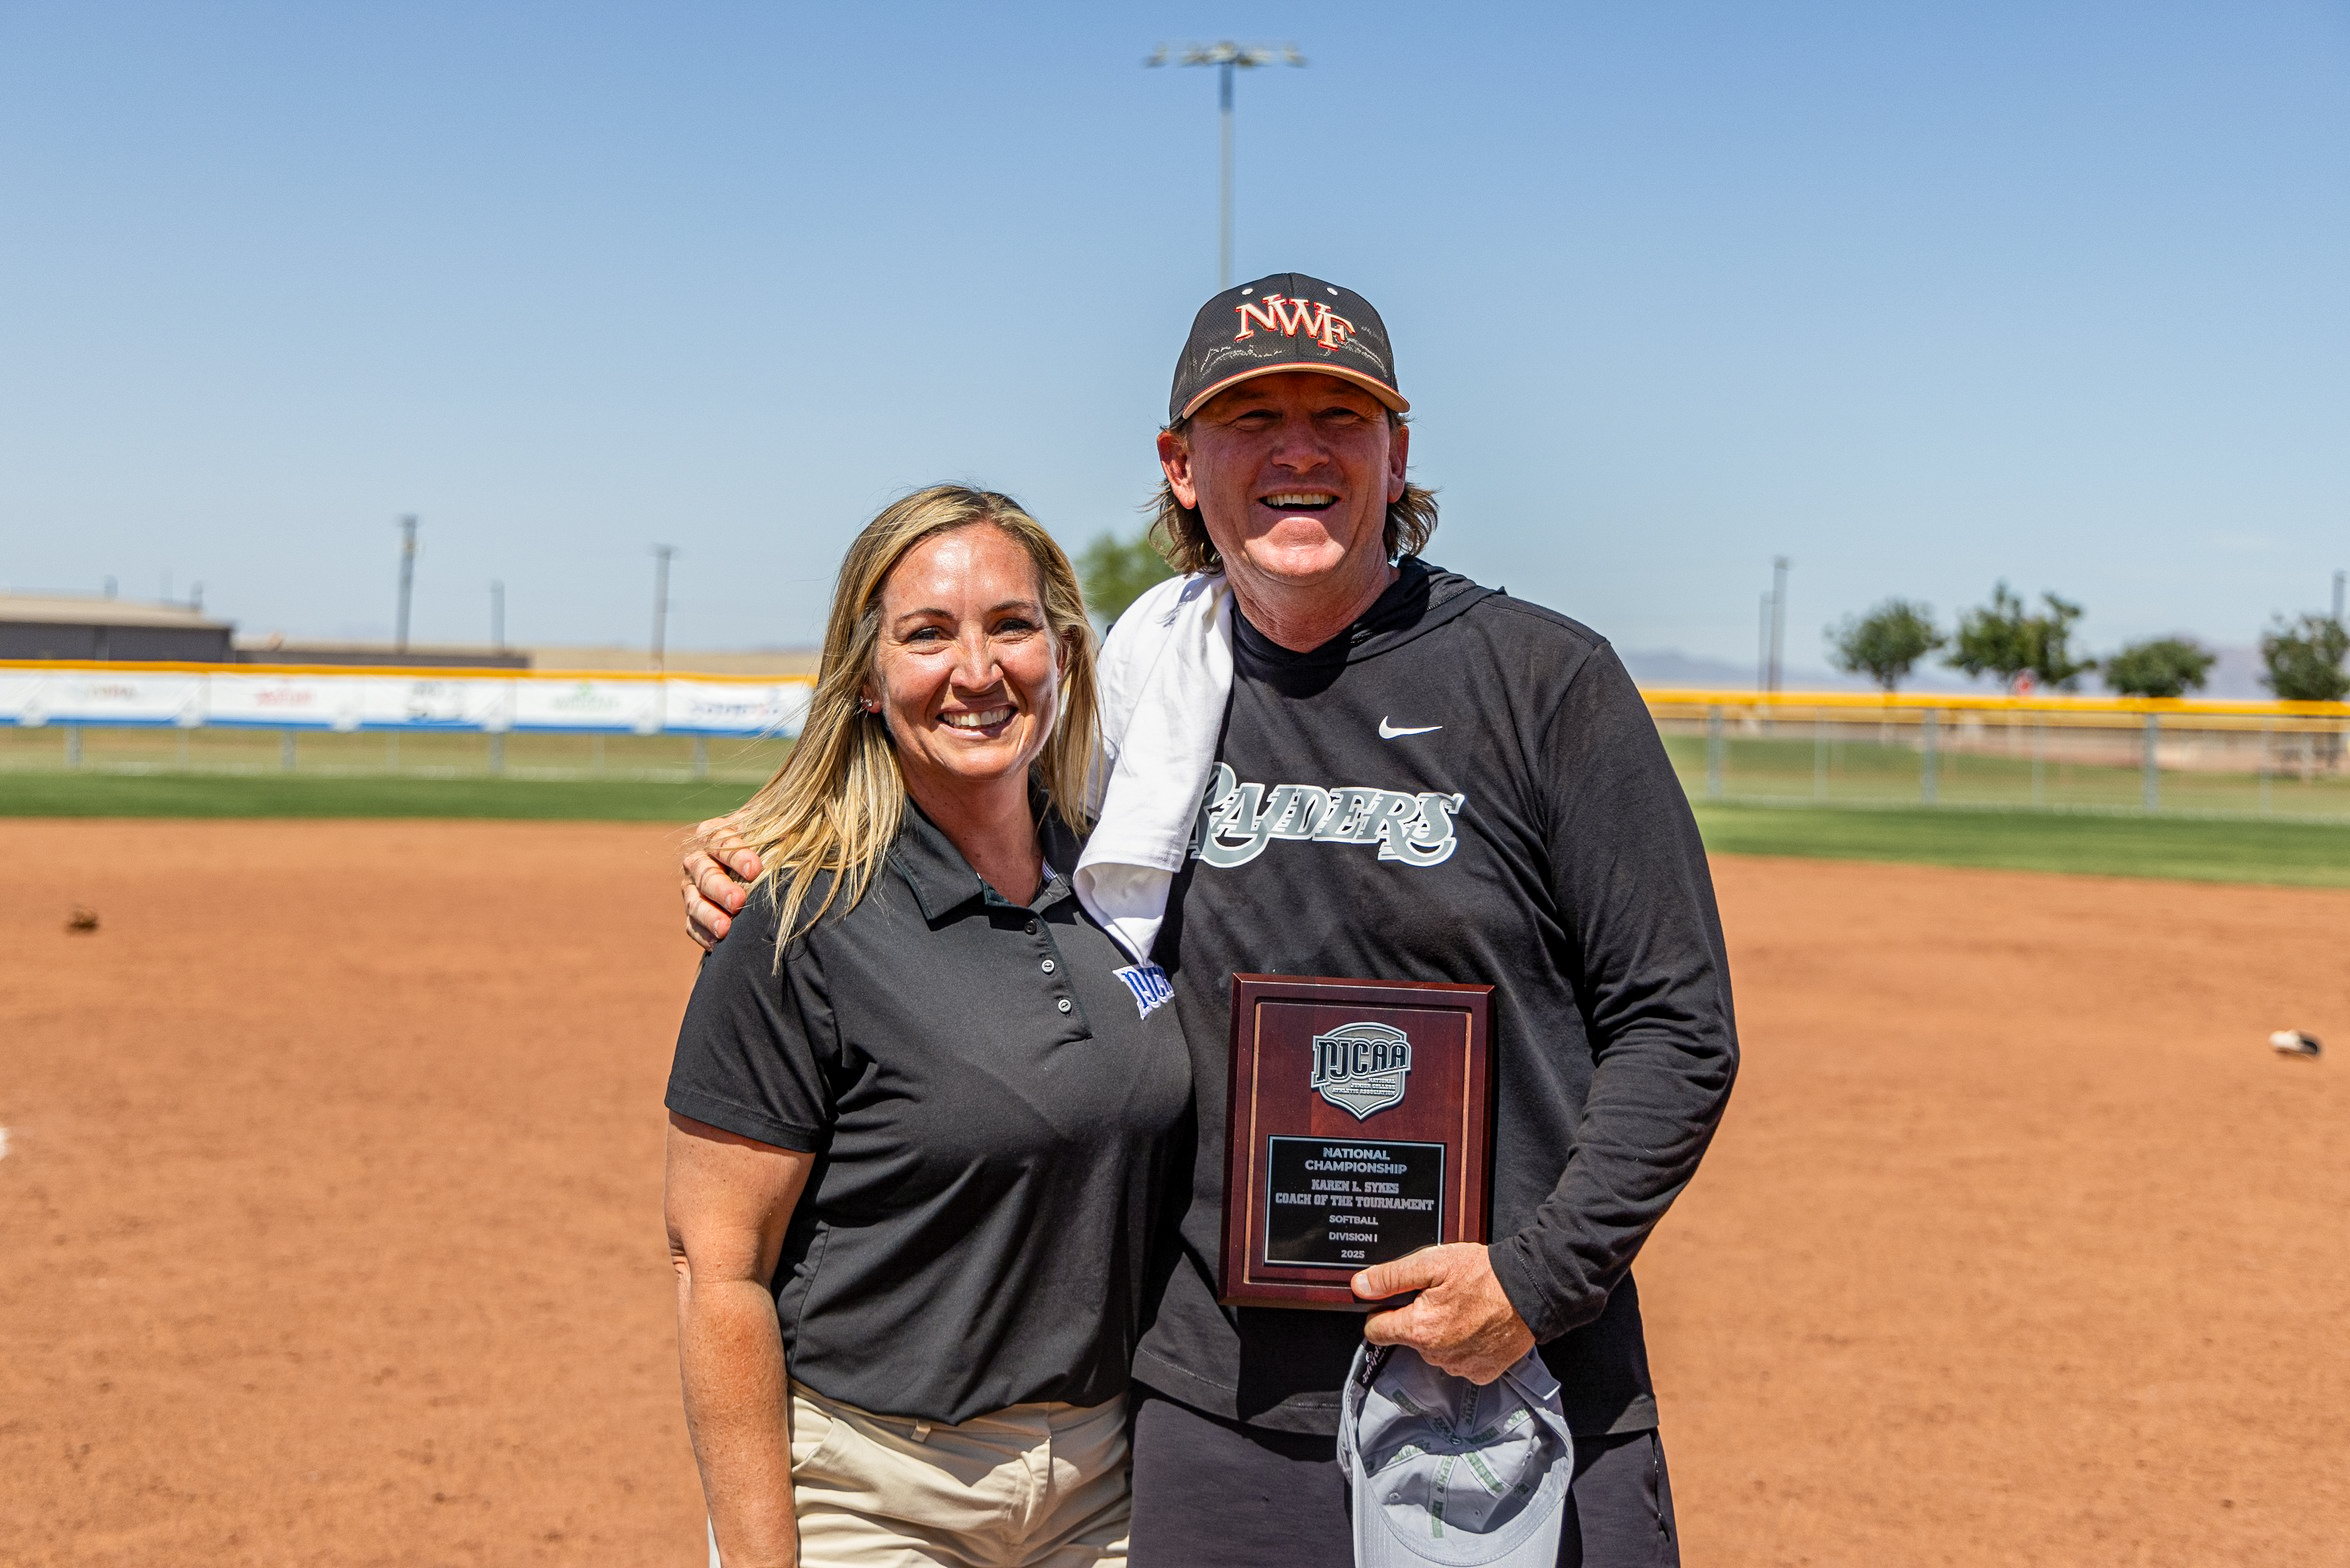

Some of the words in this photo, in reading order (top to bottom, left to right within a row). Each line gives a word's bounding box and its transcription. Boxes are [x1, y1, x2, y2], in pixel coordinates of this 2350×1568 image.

[1234, 293, 1356, 351] NWF
[1188, 761, 1466, 868] RAIDERS
[1316, 1041, 1408, 1083] NJCAA
[1322, 1147, 1390, 1161] NATIONAL
[1304, 1159, 1408, 1175] CHAMPIONSHIP
[1311, 1179, 1350, 1192] KAREN
[1352, 1180, 1362, 1192] L.
[1364, 1181, 1399, 1194] SYKES
[1275, 1192, 1311, 1205] COACH
[1313, 1194, 1328, 1206] OF
[1330, 1195, 1354, 1207] THE
[1355, 1196, 1435, 1211] TOURNAMENT
[1329, 1214, 1378, 1225] SOFTBALL
[1328, 1231, 1373, 1242] DIVISION
[1374, 1233, 1378, 1243] I
[1340, 1249, 1365, 1259] 2025
